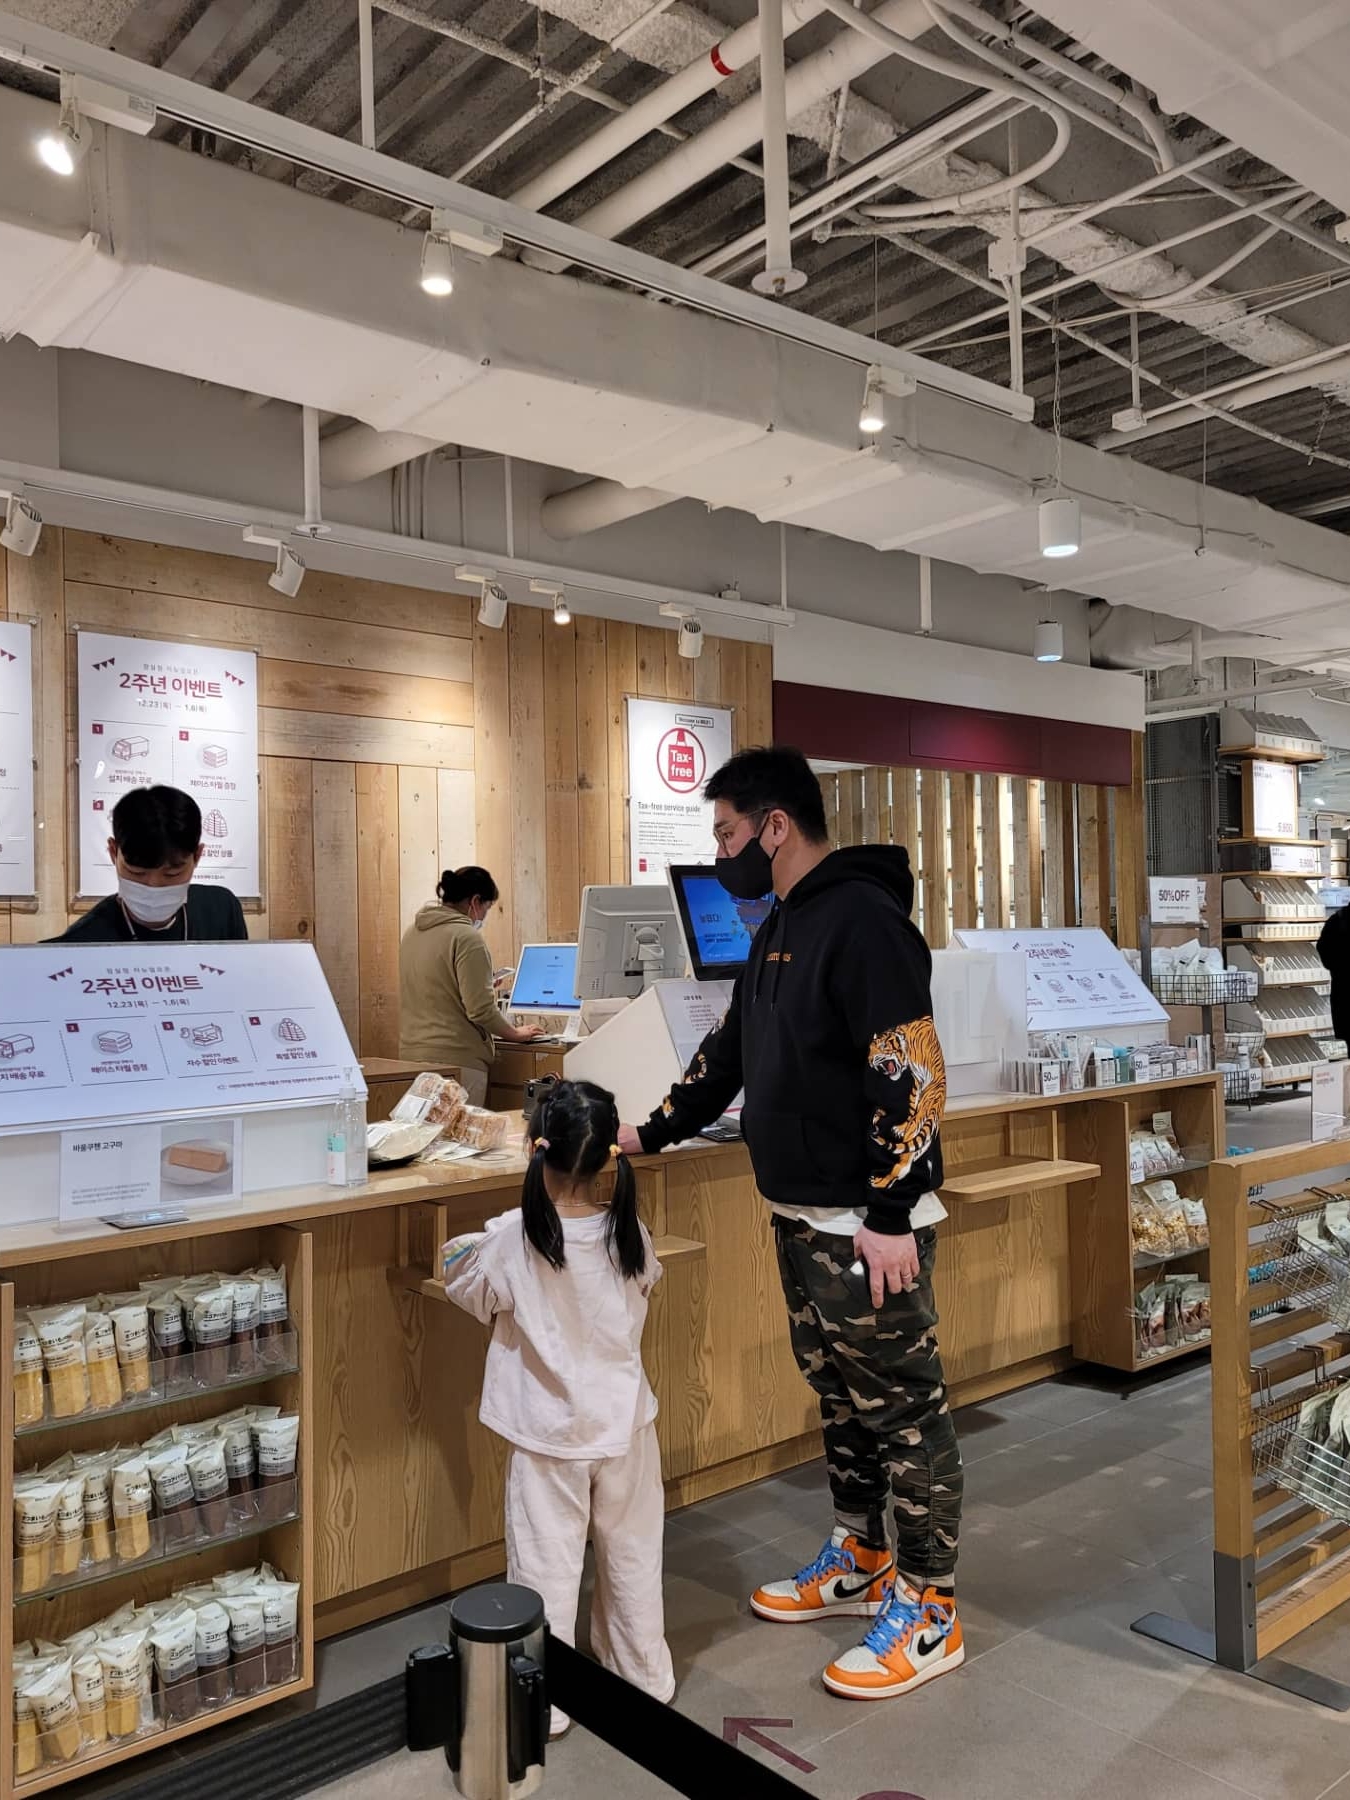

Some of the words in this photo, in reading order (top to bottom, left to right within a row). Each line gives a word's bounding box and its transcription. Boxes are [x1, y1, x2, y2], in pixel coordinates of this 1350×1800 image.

[119, 672, 167, 695] 2주년
[171, 678, 223, 699] 이벤트
[670, 750, 692, 763] Tax-
[671, 765, 693, 777] free
[638, 802, 662, 811] Tax-free
[685, 806, 701, 815] guide
[80, 977, 139, 996] 2주년
[141, 975, 204, 993] 이벤트
[102, 1141, 123, 1150] 고구마
